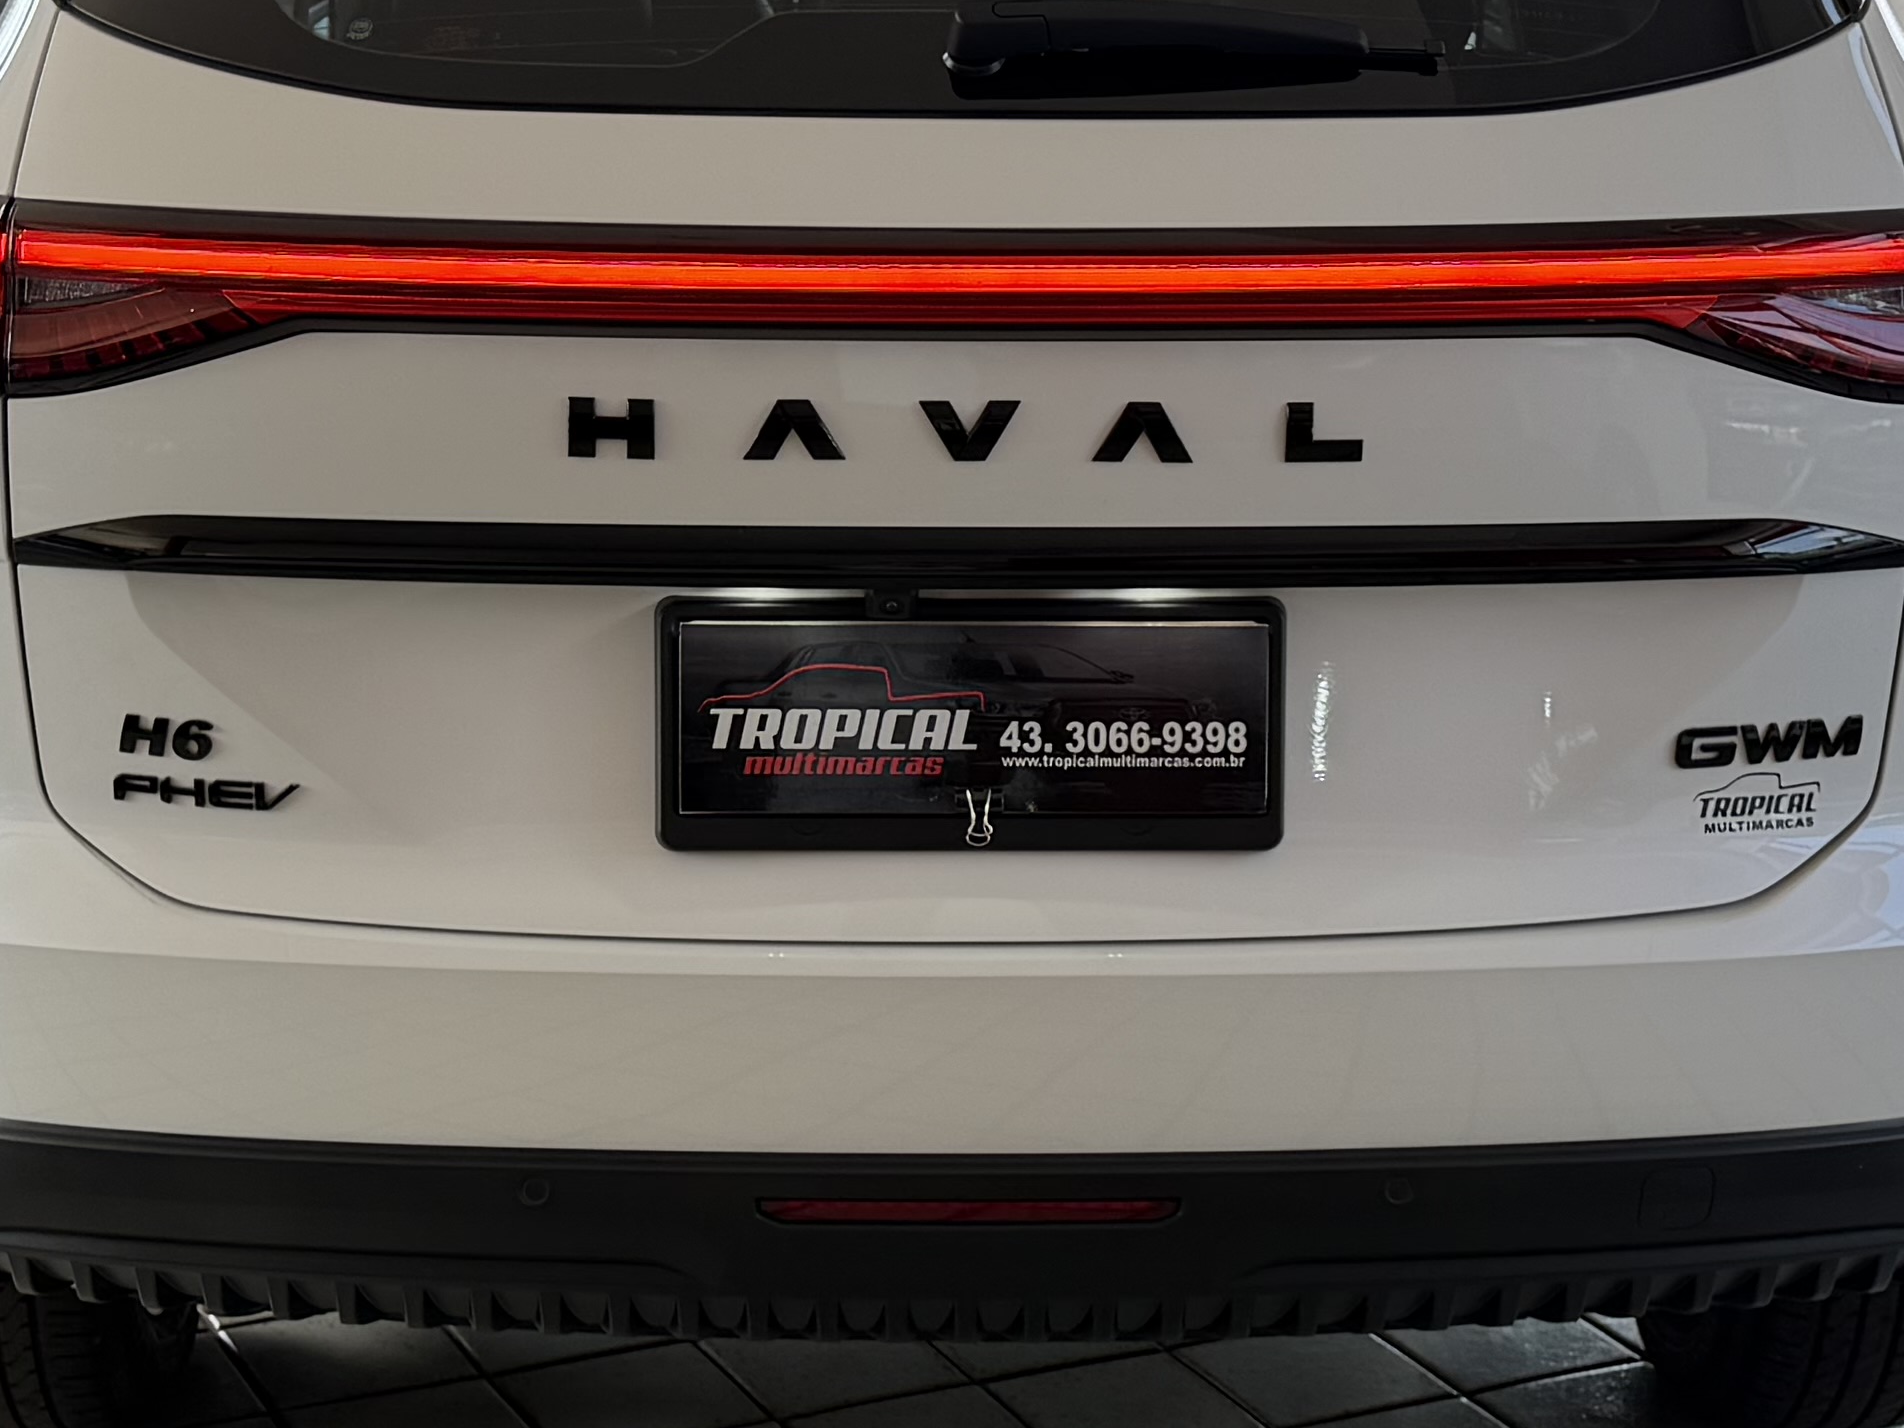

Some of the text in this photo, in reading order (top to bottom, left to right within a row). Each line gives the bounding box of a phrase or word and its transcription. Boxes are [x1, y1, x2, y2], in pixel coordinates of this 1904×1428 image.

[567, 396, 1364, 463] HAVAL
[118, 713, 214, 762] H6
[709, 707, 979, 751] TROPICAL
[998, 720, 1248, 754] 43. 3066-9398
[1674, 714, 1864, 770] GWM
[743, 751, 945, 776] multimarcas
[1000, 754, 1247, 771] www.tropicalmultimarcas.com.br
[112, 772, 301, 812] PHEV
[1699, 791, 1817, 819] TROPICAL
[1703, 816, 1815, 835] MULTIMARCAS
